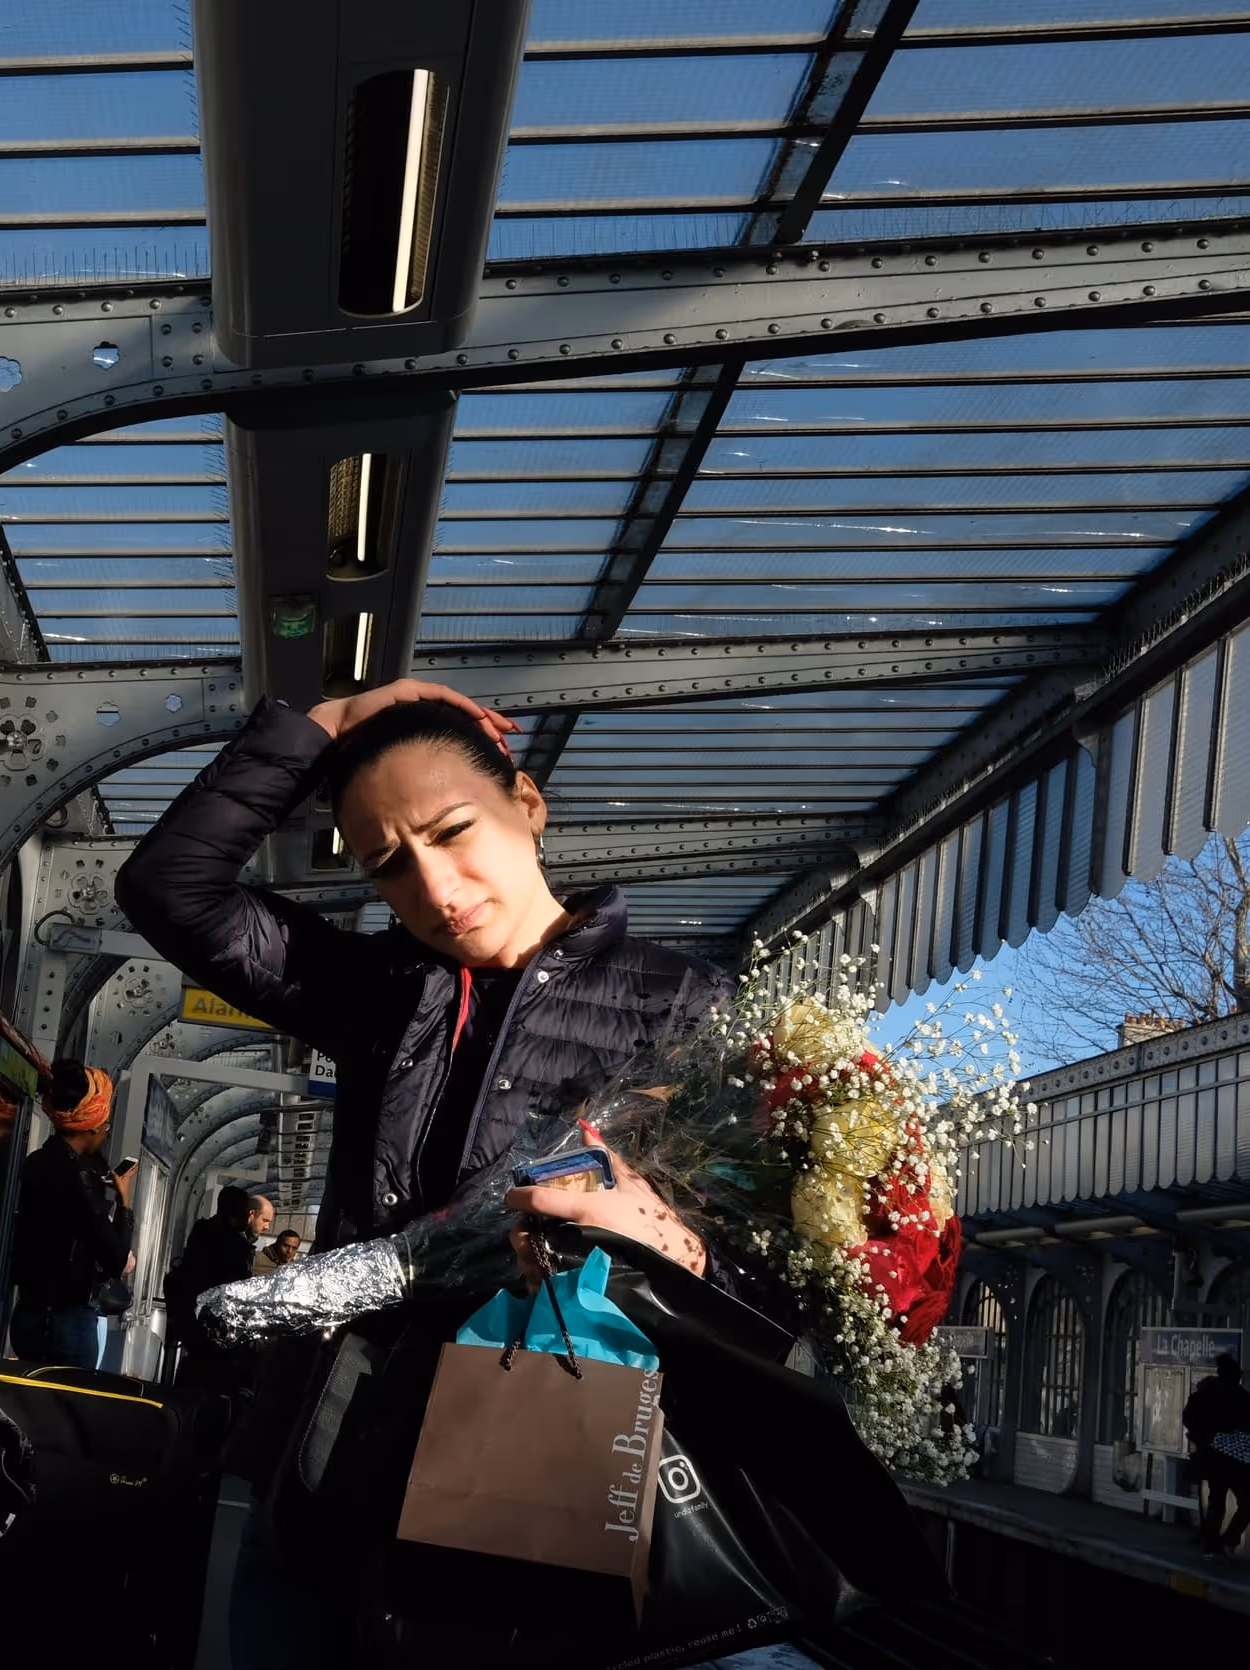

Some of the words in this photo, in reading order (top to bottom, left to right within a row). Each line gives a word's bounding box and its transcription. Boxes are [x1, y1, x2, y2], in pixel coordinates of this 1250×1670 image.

[1157, 1334, 1168, 1355] La
[1170, 1333, 1215, 1362] Chapelle
[611, 1368, 660, 1461] Bruges
[622, 1462, 642, 1484] de
[604, 1484, 639, 1544] Jeff
